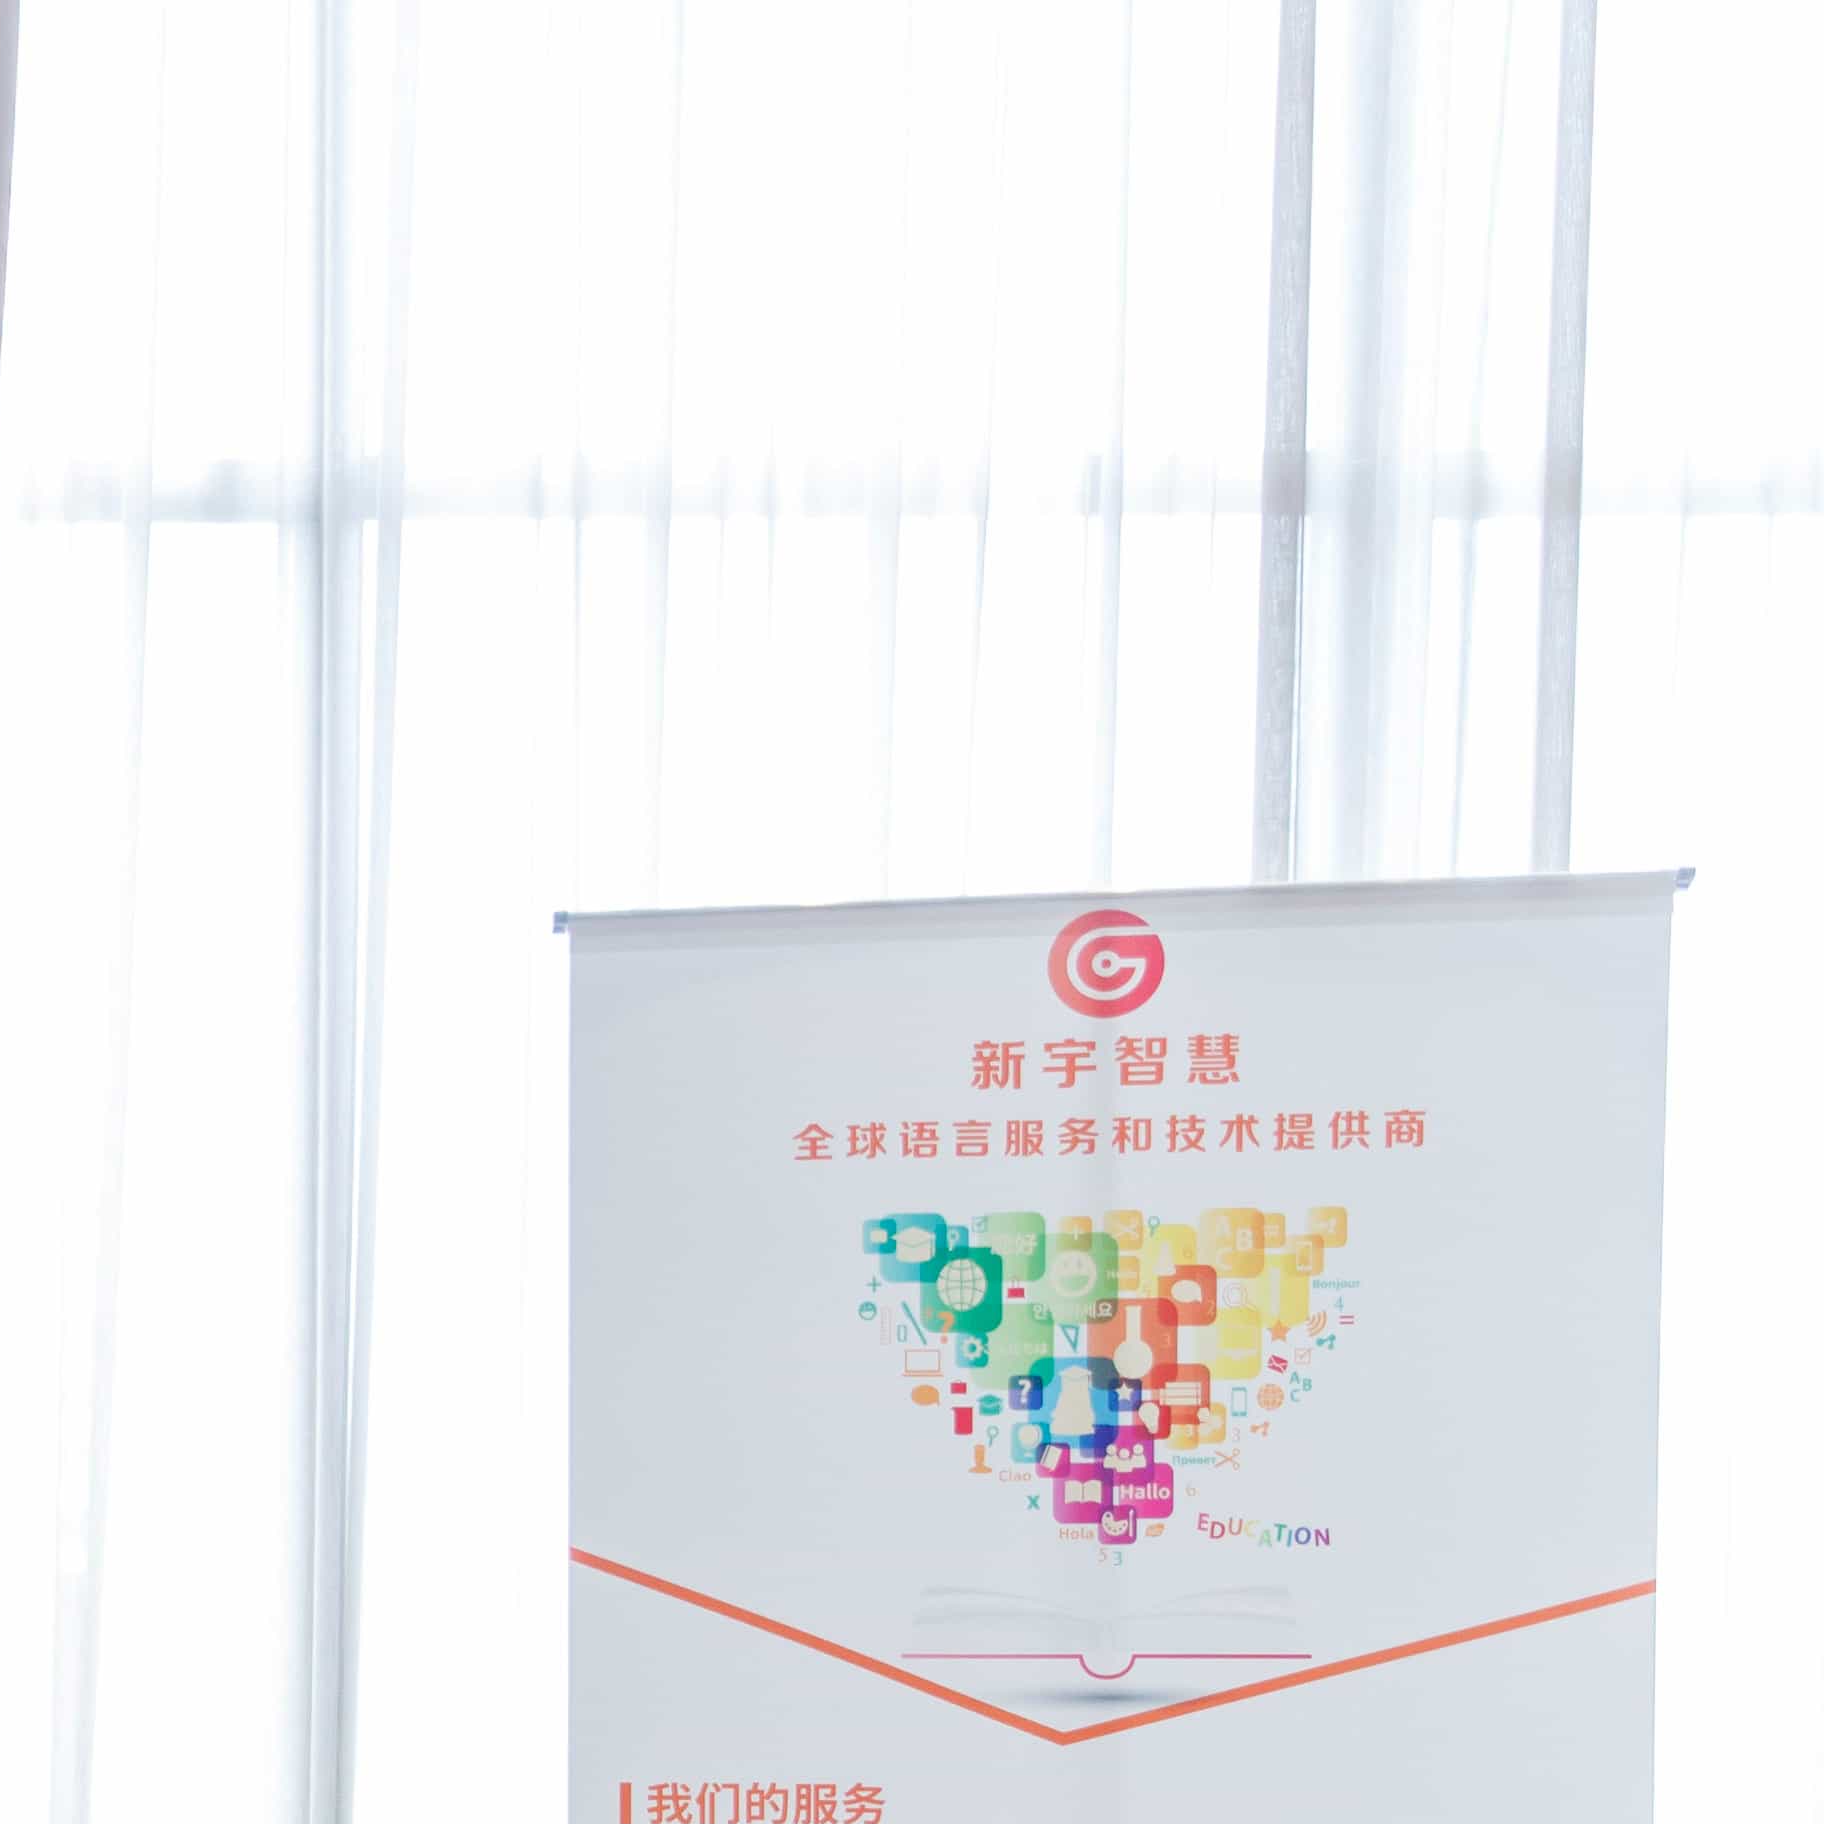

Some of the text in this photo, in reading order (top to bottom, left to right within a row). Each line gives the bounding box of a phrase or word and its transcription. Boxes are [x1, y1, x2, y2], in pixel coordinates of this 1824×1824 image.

[971, 1033, 1242, 1090] 新宇智慧
[793, 1110, 1428, 1161] 全球语言服务和技术提供商
[1312, 1278, 1361, 1291] Bonjour
[1119, 1484, 1171, 1500] Hallo
[1058, 1527, 1095, 1541] Hola
[1197, 1512, 1331, 1547] EDUCATION
